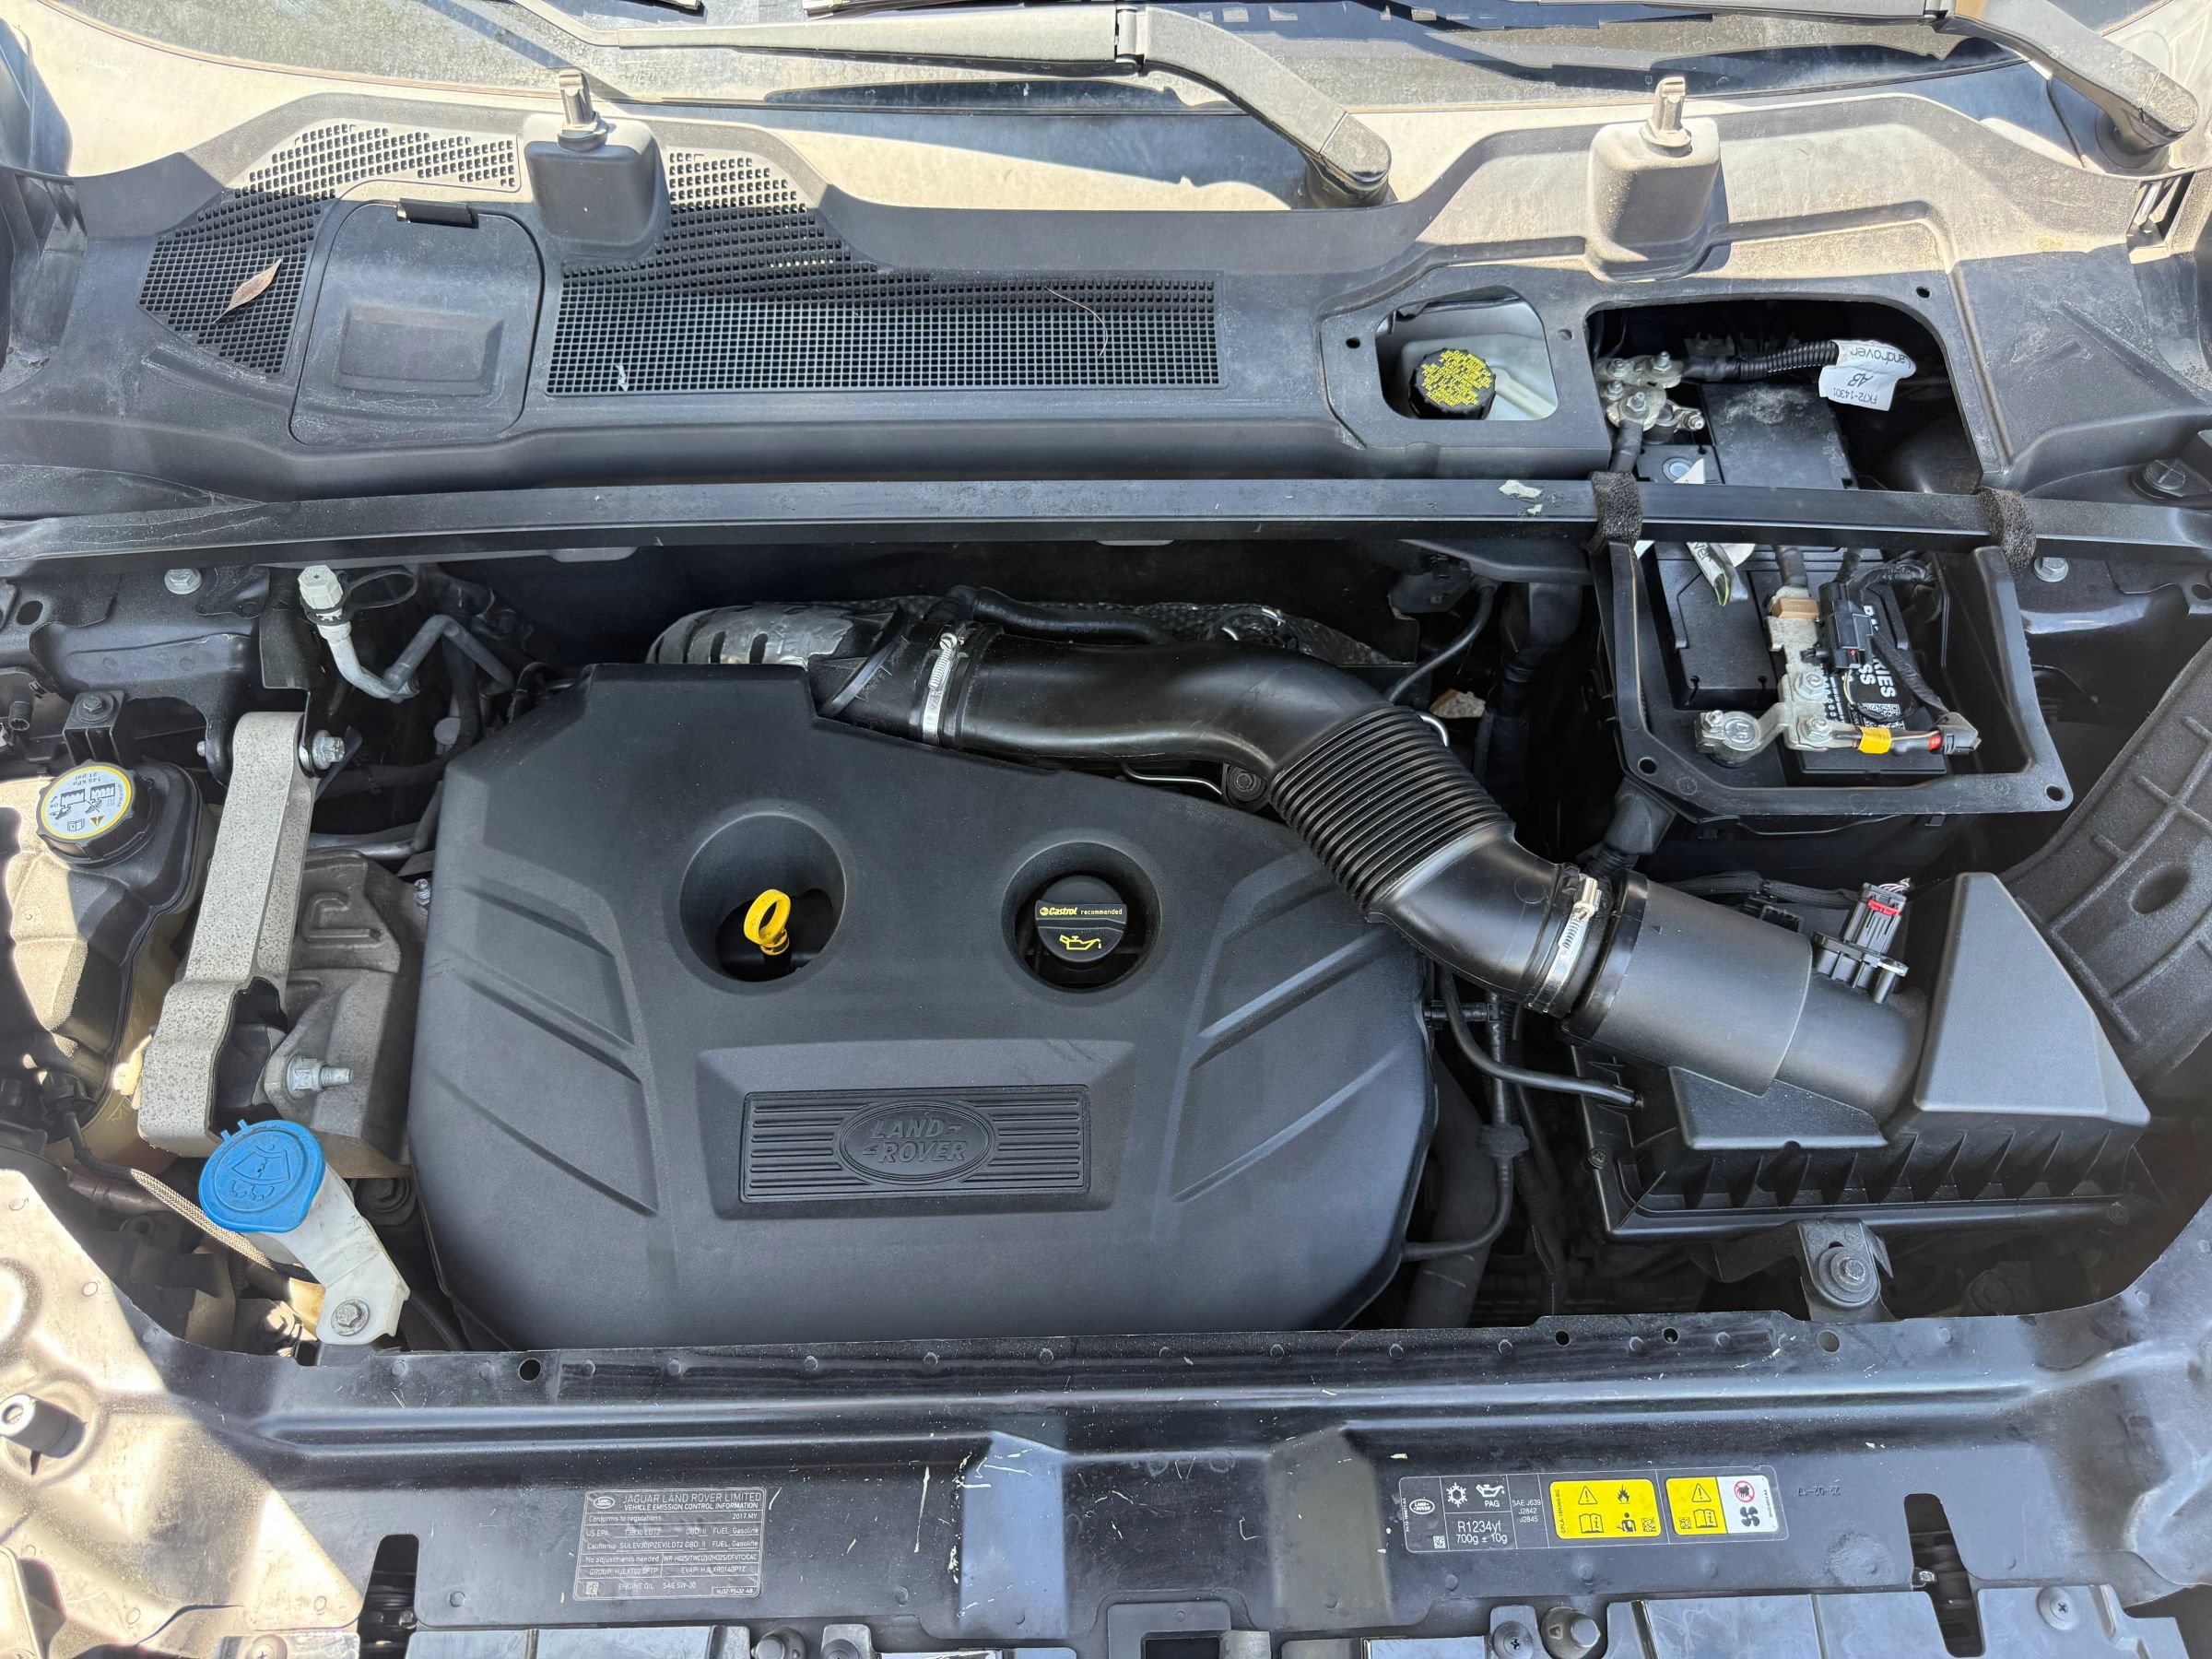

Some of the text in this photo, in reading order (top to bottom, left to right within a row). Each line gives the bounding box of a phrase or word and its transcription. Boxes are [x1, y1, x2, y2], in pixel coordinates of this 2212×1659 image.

[1847, 372, 1874, 387] AB
[1049, 907, 1078, 915] Castrol
[872, 1117, 945, 1140] LAND
[877, 1140, 968, 1163] ROVER
[622, 1494, 659, 1504] JAGUAR
[663, 1493, 688, 1503] LAND
[691, 1492, 723, 1502] ROVER
[724, 1492, 762, 1502] LIMITED
[624, 1503, 651, 1512] VEHICLE
[684, 1502, 714, 1511] CONTROL
[585, 1529, 595, 1537] US
[1457, 1521, 1501, 1534] R1234yf
[1455, 1534, 1479, 1545] 700g
[1490, 1534, 1508, 1545] 10g
[636, 1555, 660, 1563] needed
[618, 1582, 642, 1591] ENGINE
[643, 1582, 654, 1590] OIL
[663, 1581, 676, 1590] SAE
